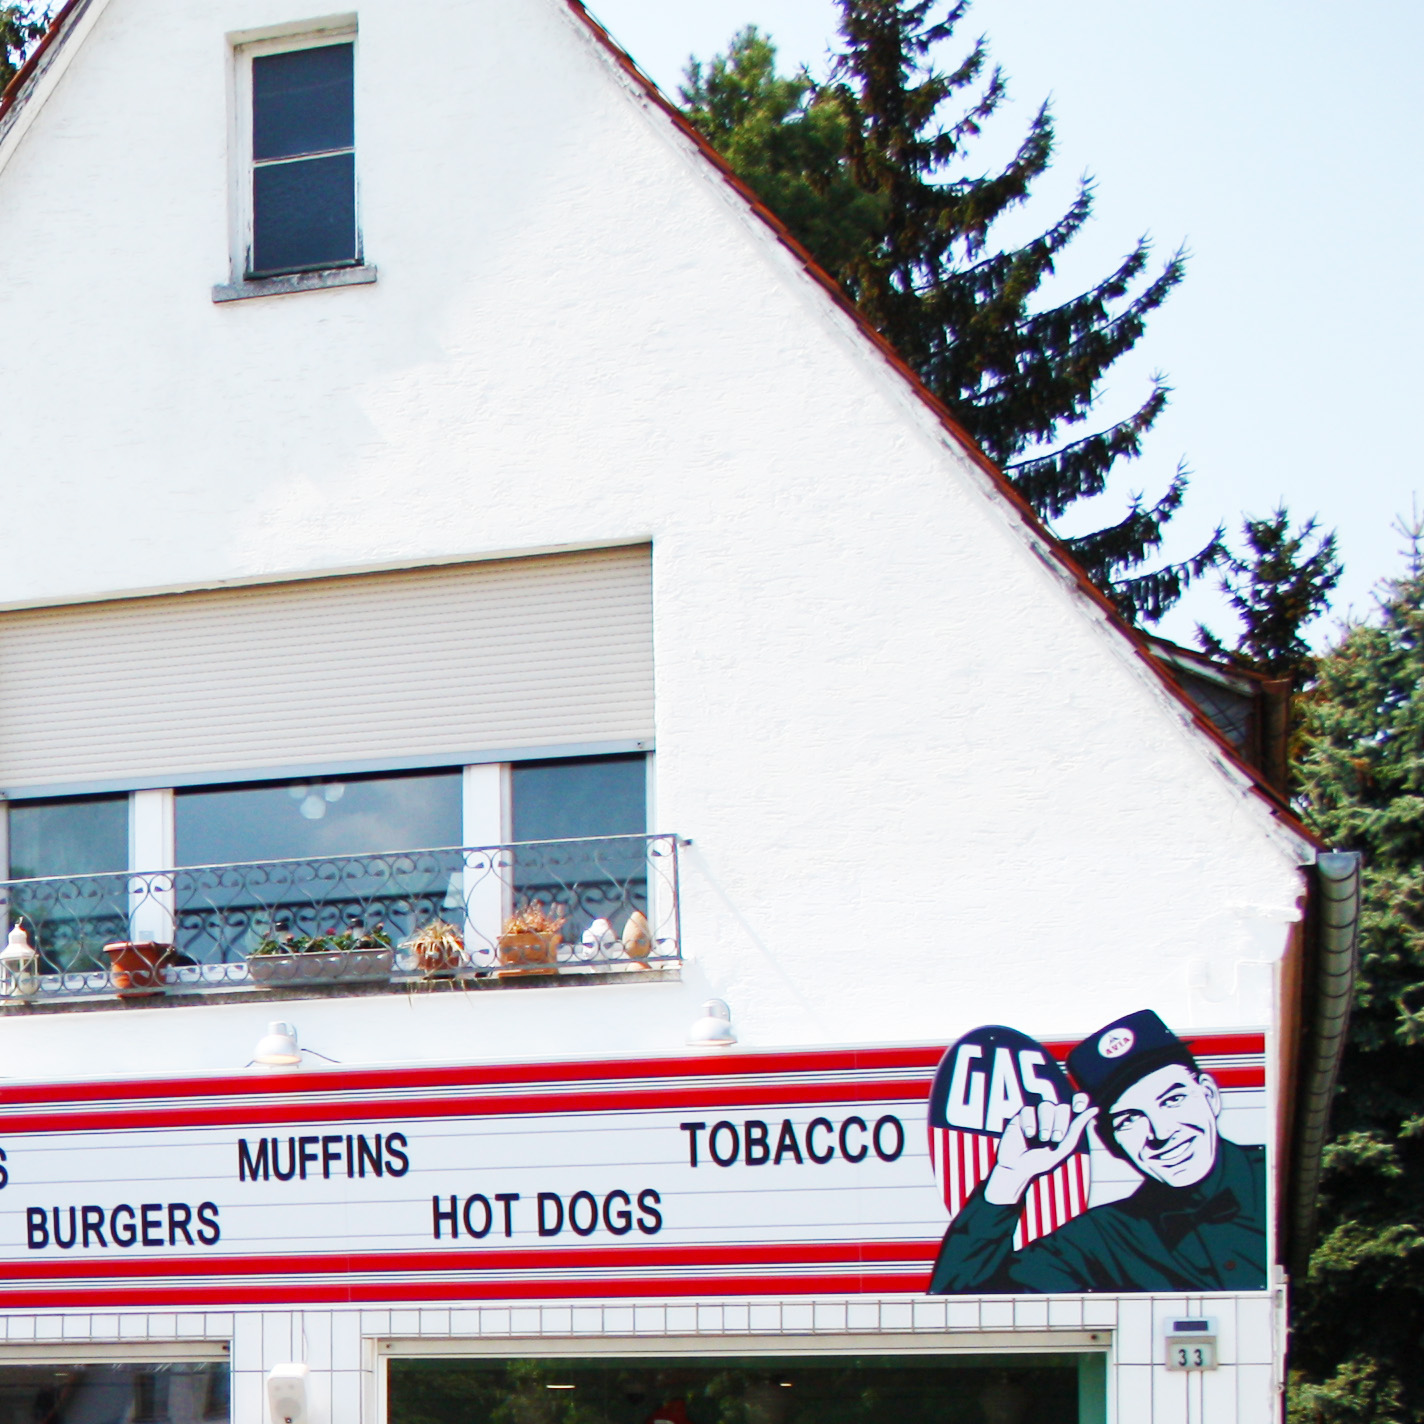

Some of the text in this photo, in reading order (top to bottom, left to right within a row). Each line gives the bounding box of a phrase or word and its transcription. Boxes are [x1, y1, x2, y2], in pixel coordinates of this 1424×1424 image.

[946, 1044, 1058, 1132] GAS
[237, 1131, 410, 1182] MUFFINS
[679, 1114, 905, 1168] TOBACCO
[26, 1201, 221, 1250] BURGERS
[432, 1188, 663, 1240] HOT DOGS
[1178, 1348, 1203, 1367] 33
